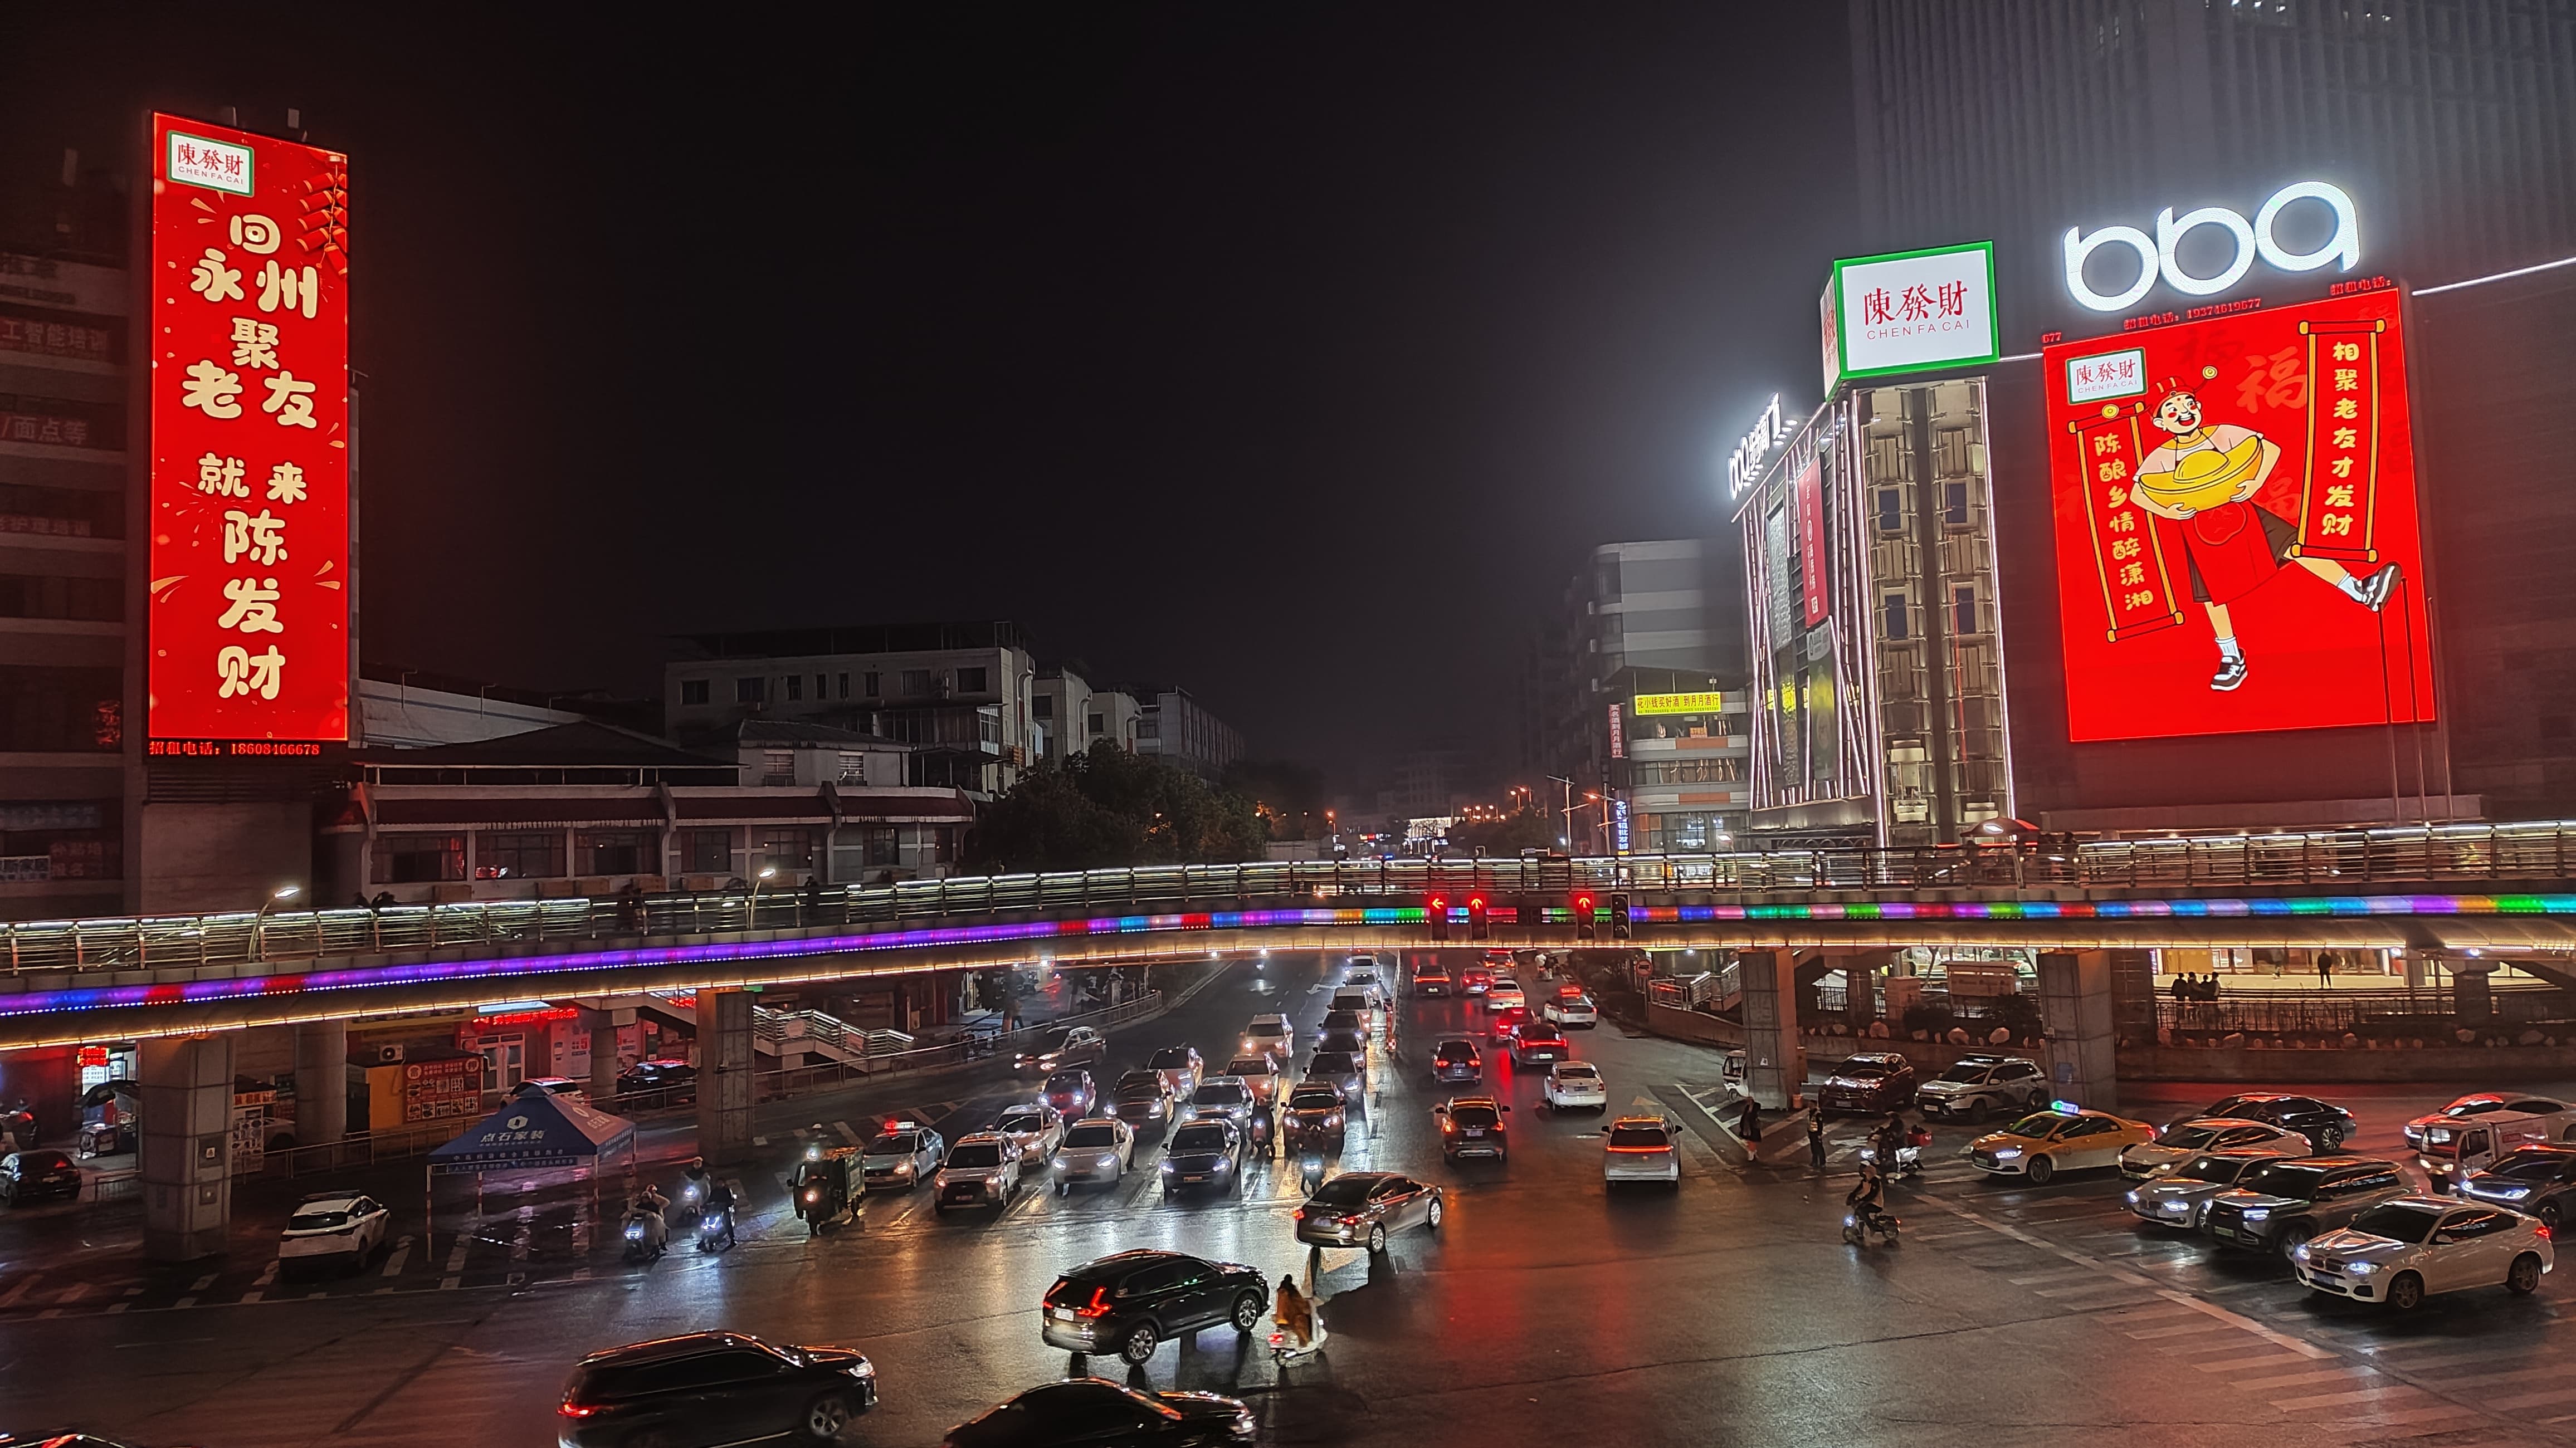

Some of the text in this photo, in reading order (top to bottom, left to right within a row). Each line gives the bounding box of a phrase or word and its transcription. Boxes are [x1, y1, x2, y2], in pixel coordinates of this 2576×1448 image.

[178, 143, 244, 176] 陳發財
[178, 166, 243, 185] CHEN FA CAI
[230, 214, 280, 254] 回
[190, 248, 318, 319] 永州
[1863, 280, 1968, 326] 陳發財
[230, 317, 279, 370] 聚
[1866, 319, 1970, 340] CHEN FA CAI
[182, 360, 317, 429] 老友
[2076, 359, 2136, 386] 陳發財
[2078, 384, 2104, 394] CHEN
[2235, 345, 2307, 414] 福
[2321, 341, 2360, 536] 相聚老友才发财
[198, 452, 307, 505] 就来
[2093, 432, 2154, 612] 陈酿乡情醉潇湘
[217, 508, 288, 700] 陈发财
